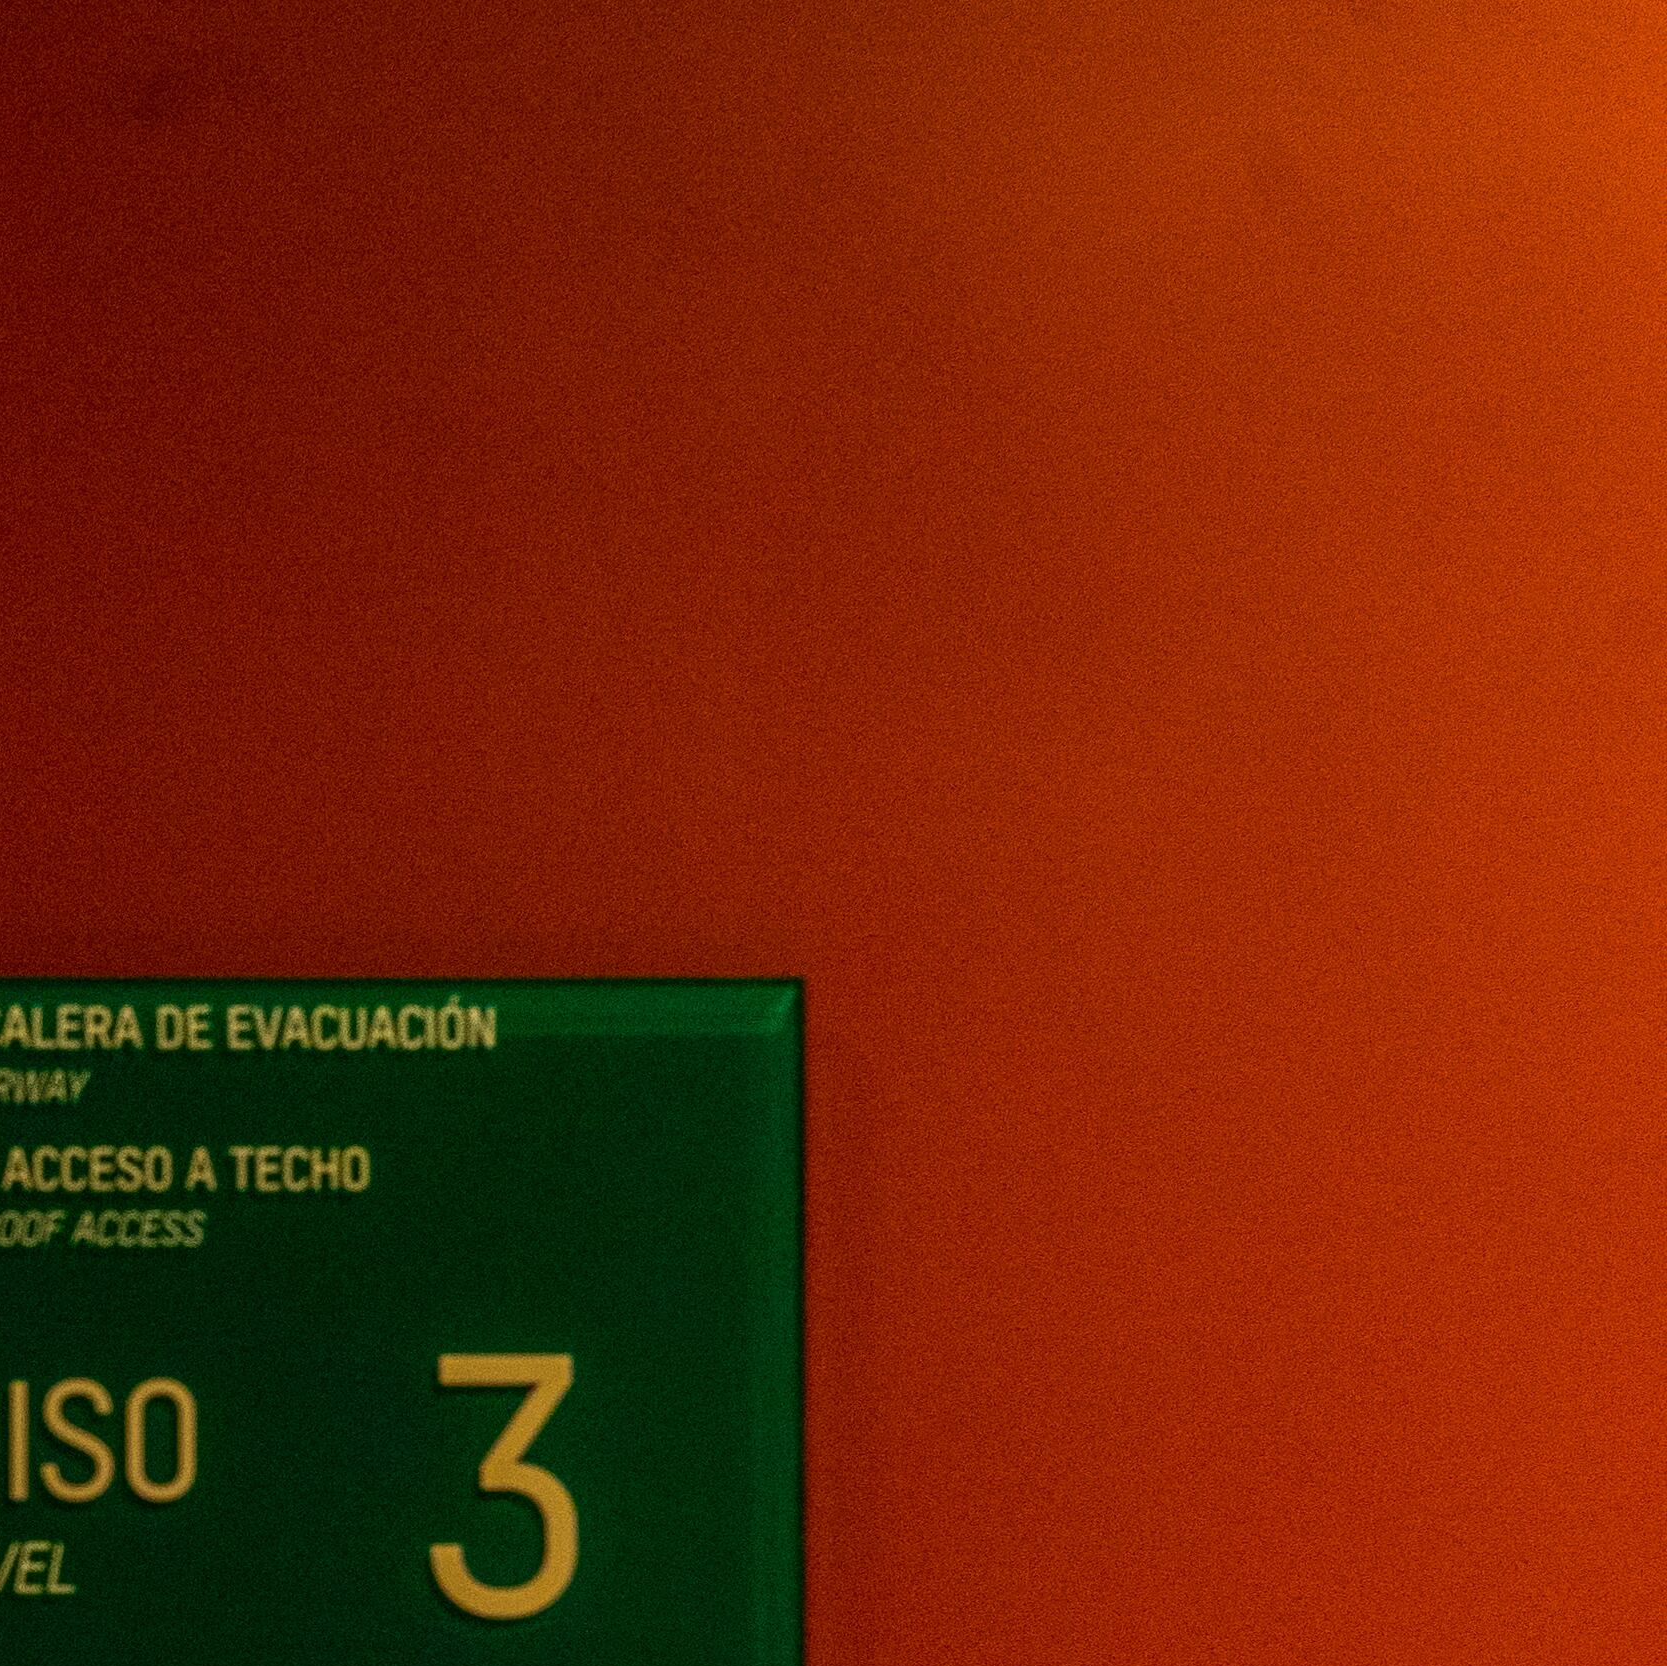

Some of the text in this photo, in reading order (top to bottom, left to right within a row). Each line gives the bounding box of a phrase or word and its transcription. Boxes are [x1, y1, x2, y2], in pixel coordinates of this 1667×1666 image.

[156, 1004, 211, 1050] DE
[227, 997, 496, 1050] EVACUACIÓN
[2, 1145, 172, 1192] ACCESO
[185, 1146, 217, 1191] A
[230, 1146, 370, 1192] TECHO
[72, 1210, 207, 1247] ACCESS
[431, 1354, 578, 1618] 3
